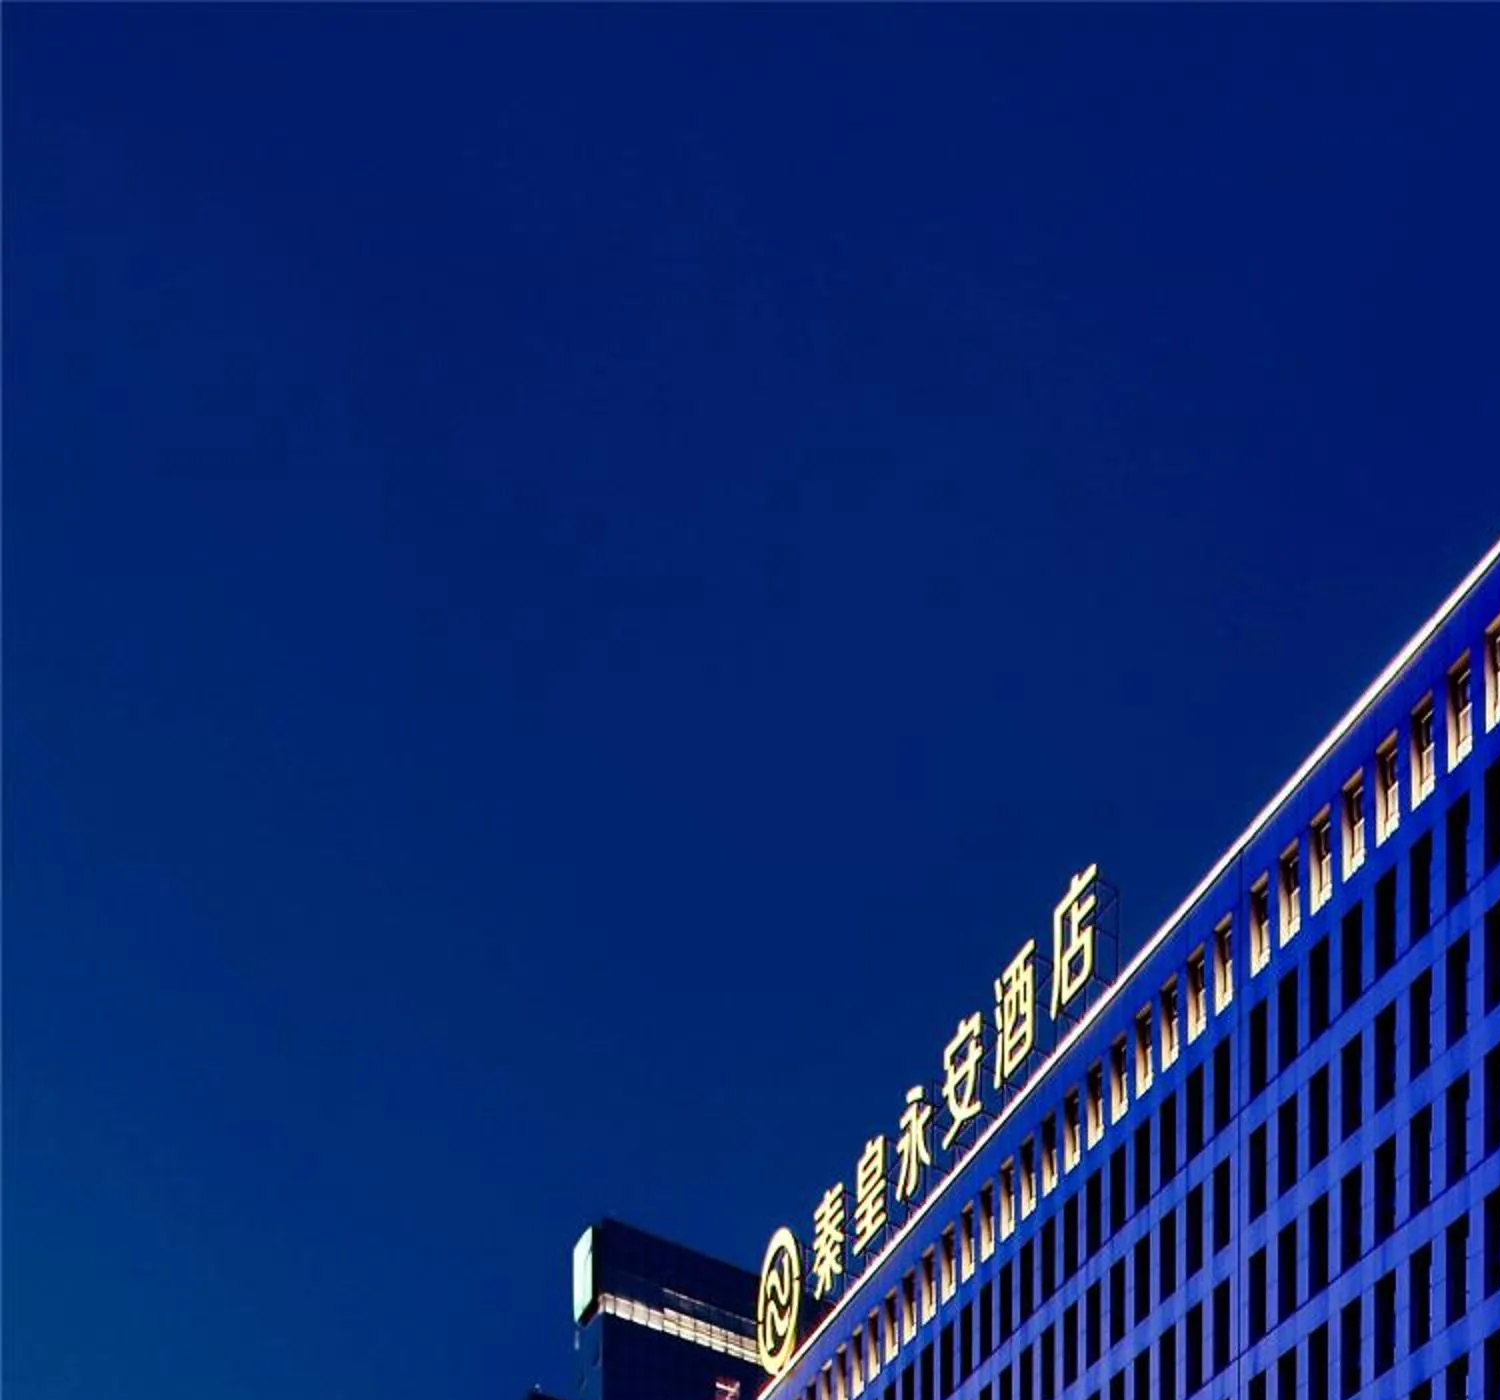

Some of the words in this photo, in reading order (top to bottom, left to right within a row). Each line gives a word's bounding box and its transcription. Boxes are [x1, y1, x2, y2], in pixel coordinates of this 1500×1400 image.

[812, 863, 1097, 1300] 秦皇永安酒店
